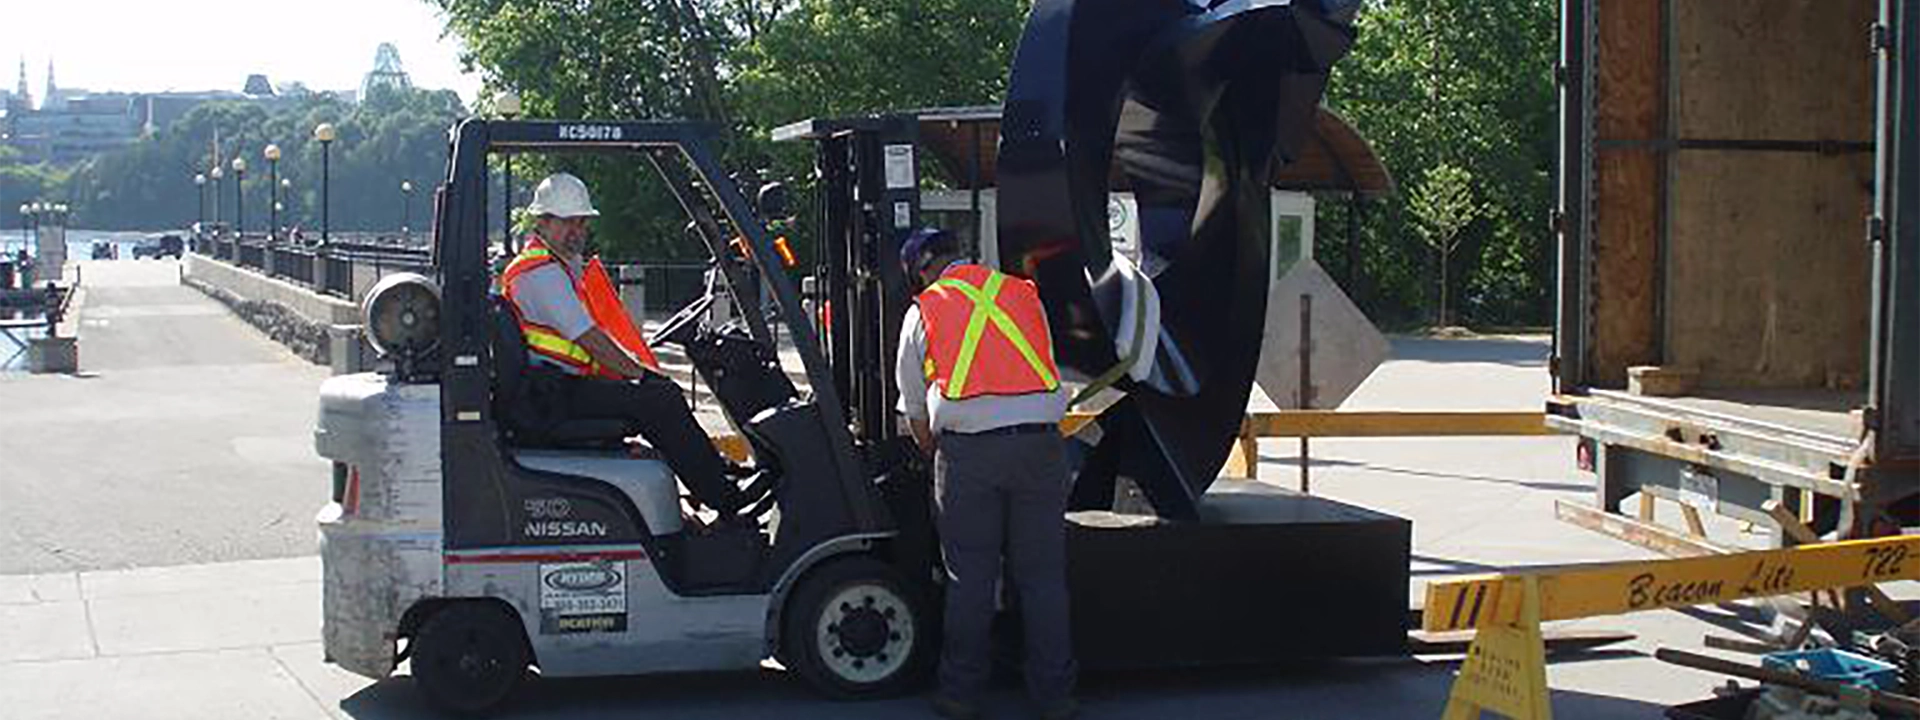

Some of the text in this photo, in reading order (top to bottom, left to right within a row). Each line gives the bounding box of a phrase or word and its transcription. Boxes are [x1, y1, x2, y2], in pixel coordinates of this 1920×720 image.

[524, 521, 607, 537] NISSAN
[1628, 572, 1724, 609] Beacon
[1739, 558, 1796, 595] Lite
